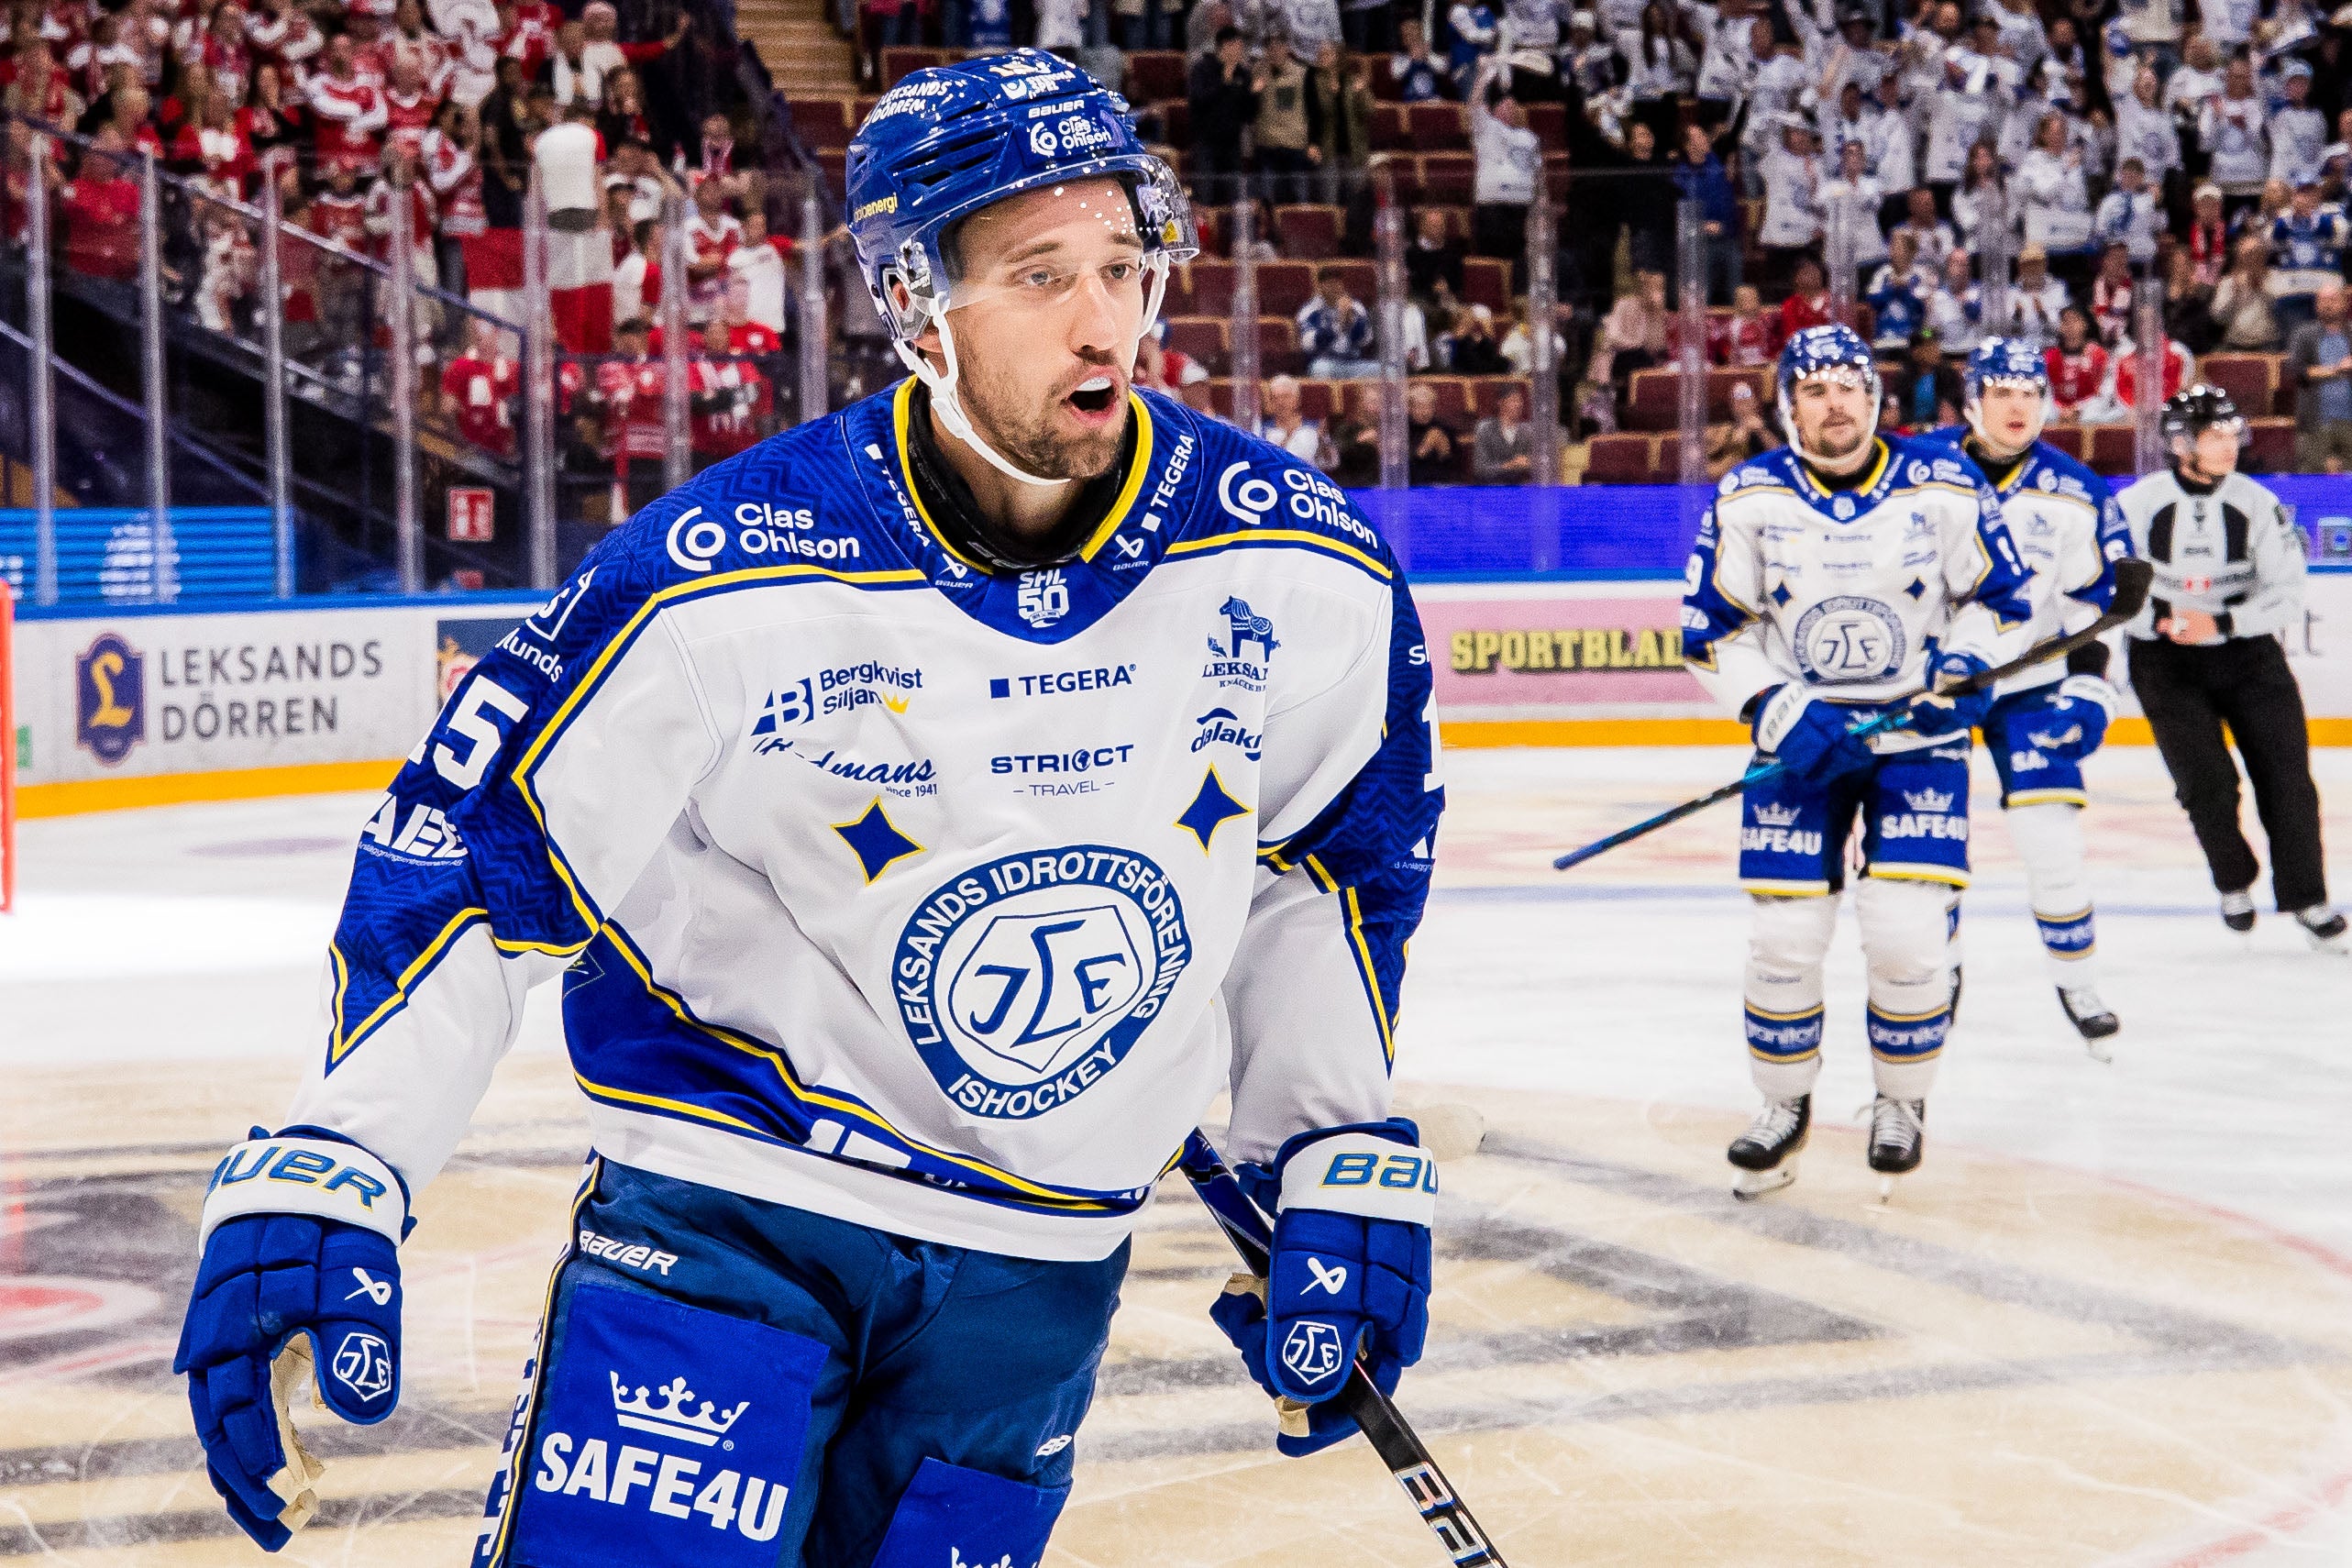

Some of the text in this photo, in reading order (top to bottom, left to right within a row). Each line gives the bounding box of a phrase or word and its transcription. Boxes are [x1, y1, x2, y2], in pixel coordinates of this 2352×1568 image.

[1151, 435, 1194, 507] TEGERA
[1284, 469, 1346, 505] Clas
[734, 502, 813, 530] Clas
[1289, 492, 1377, 549] Ohlson
[739, 529, 860, 559] Ohlson
[1019, 569, 1066, 589] SHL
[1018, 585, 1069, 620] 50
[160, 641, 382, 688] LEKSANDS
[820, 660, 922, 692] Bergkvist
[161, 690, 337, 741] DÖRREN
[823, 687, 882, 715] Siljan
[915, 783, 937, 798] 1941
[1029, 780, 1100, 796] TRAVEL
[900, 851, 1187, 1045] LEKSANDS IDROTTSFÖRENING
[948, 1038, 1117, 1117] ISHOCKEY
[536, 1431, 790, 1542] SAFE4U
